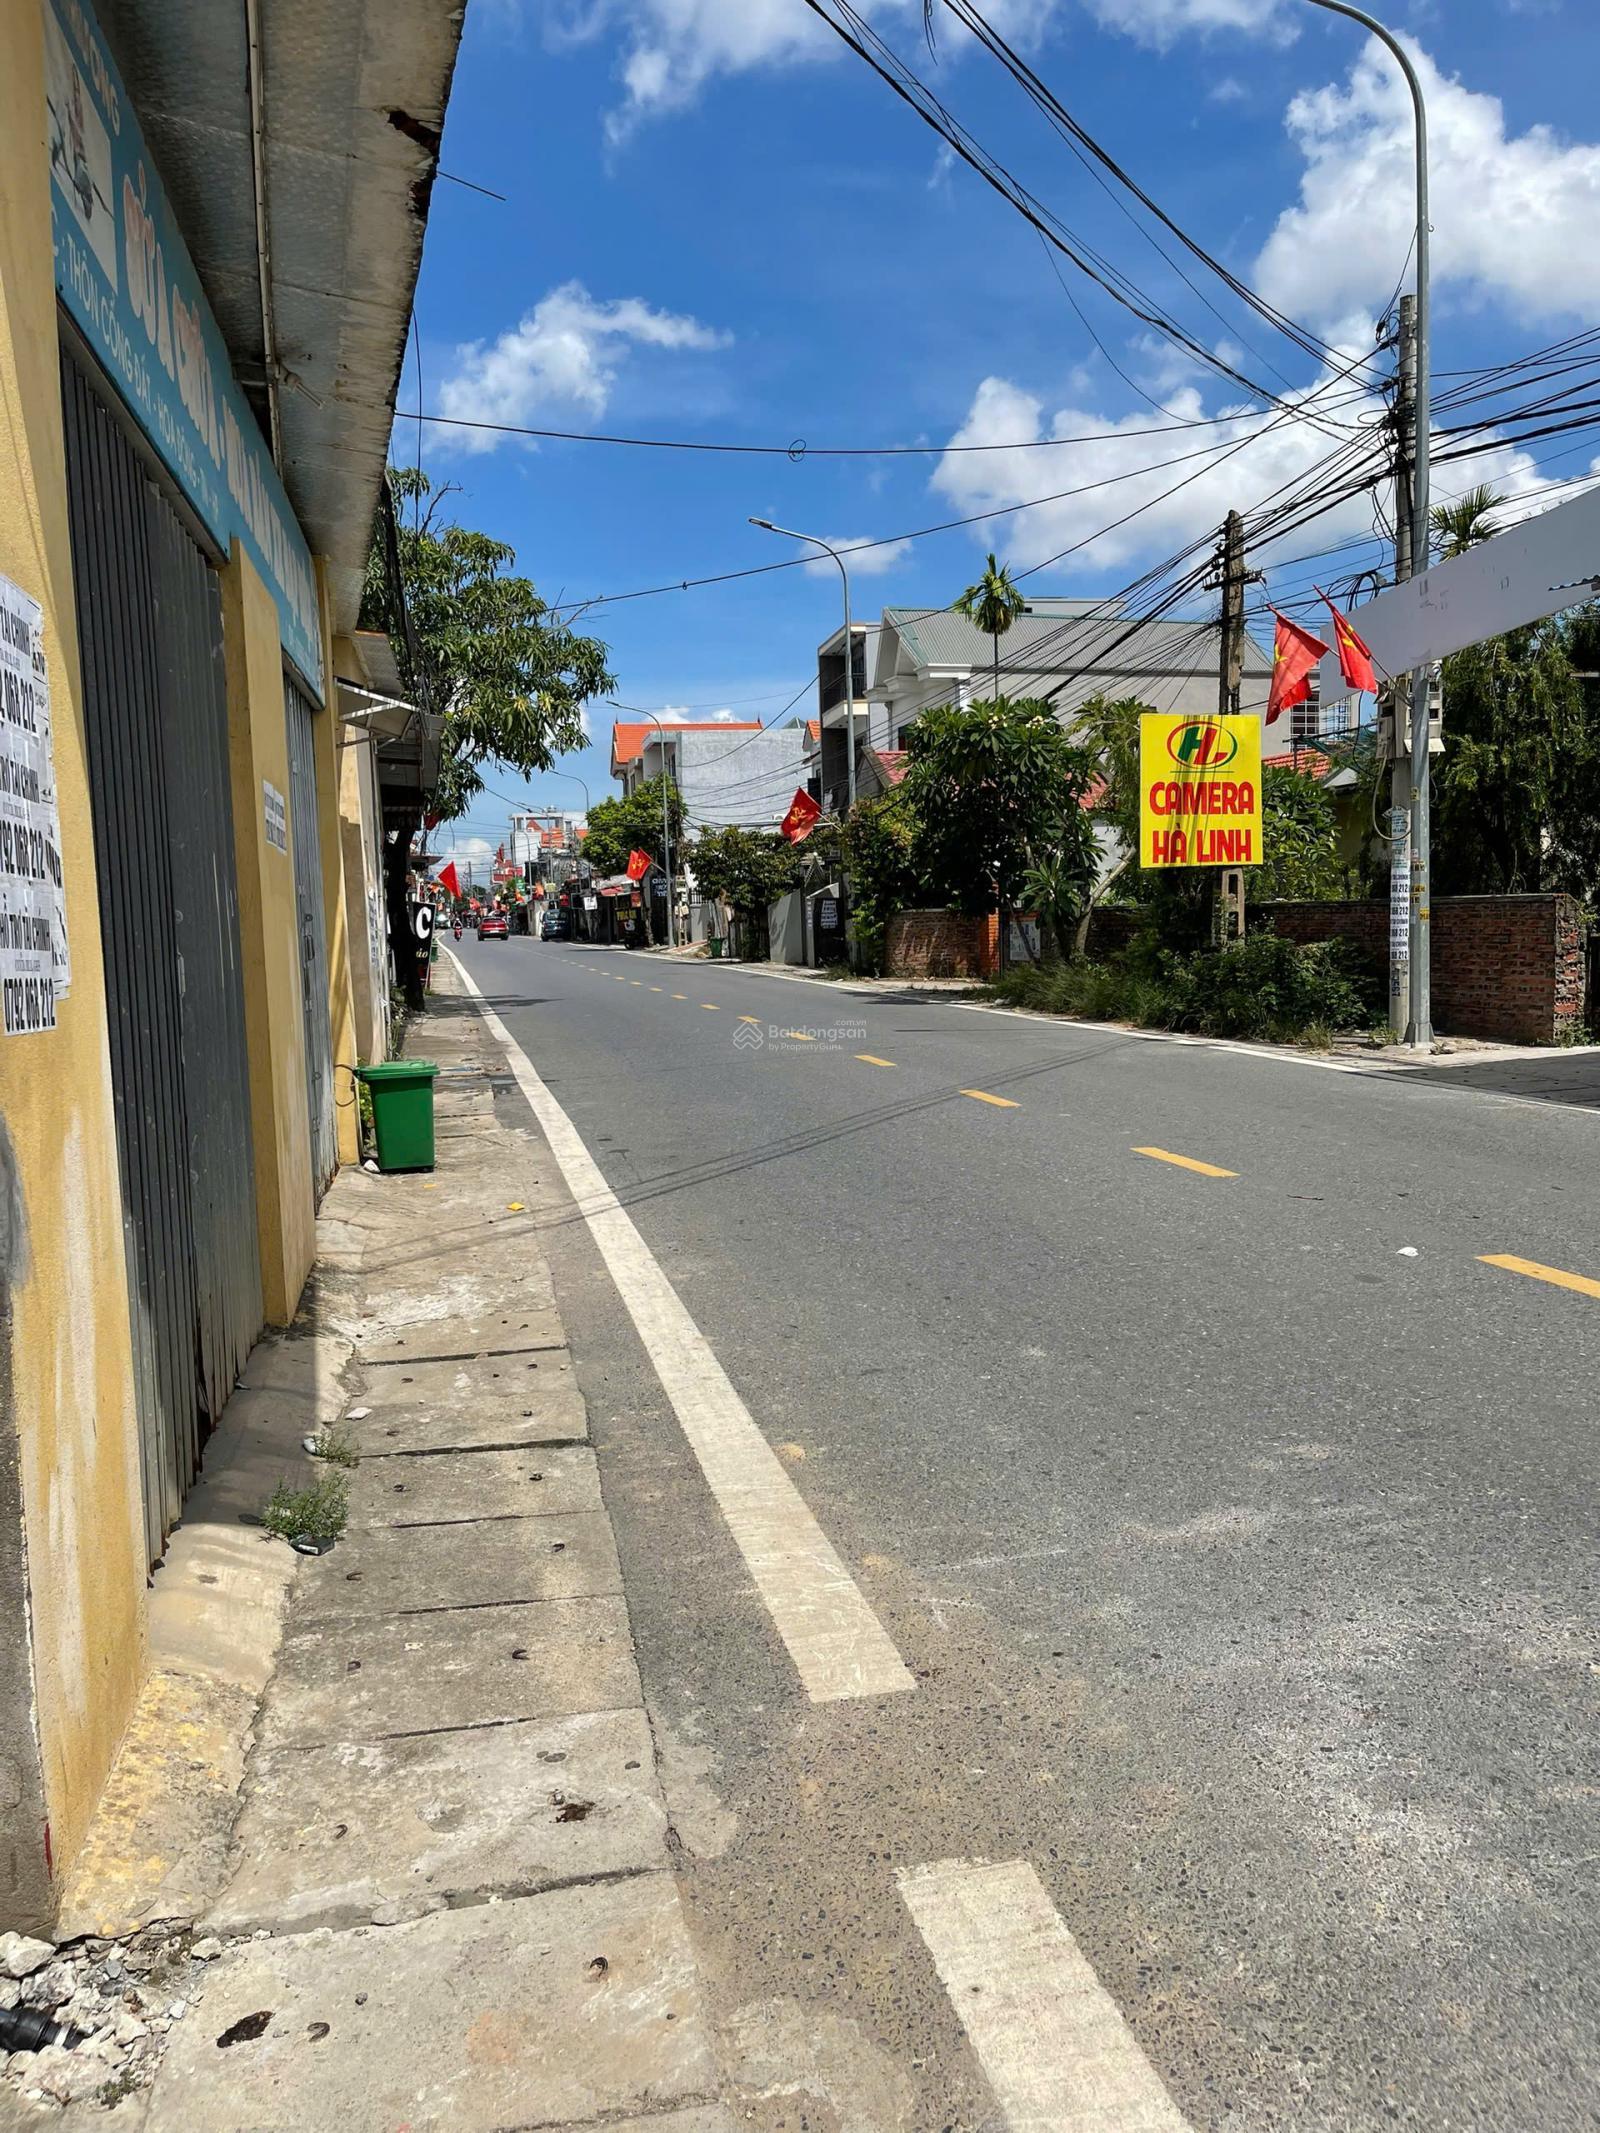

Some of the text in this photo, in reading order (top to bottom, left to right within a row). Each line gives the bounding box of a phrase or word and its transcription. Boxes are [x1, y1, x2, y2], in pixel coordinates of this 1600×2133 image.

[67, 232, 99, 329] THÔN
[20, 678, 37, 733] 212
[1178, 726, 1228, 765] HL
[1150, 781, 1254, 816] CAMERA
[29, 828, 45, 880] 212
[1152, 823, 1252, 864] HÀ LINH
[32, 907, 51, 951] CHÍNH
[3, 977, 55, 1032] 0792 068 212
